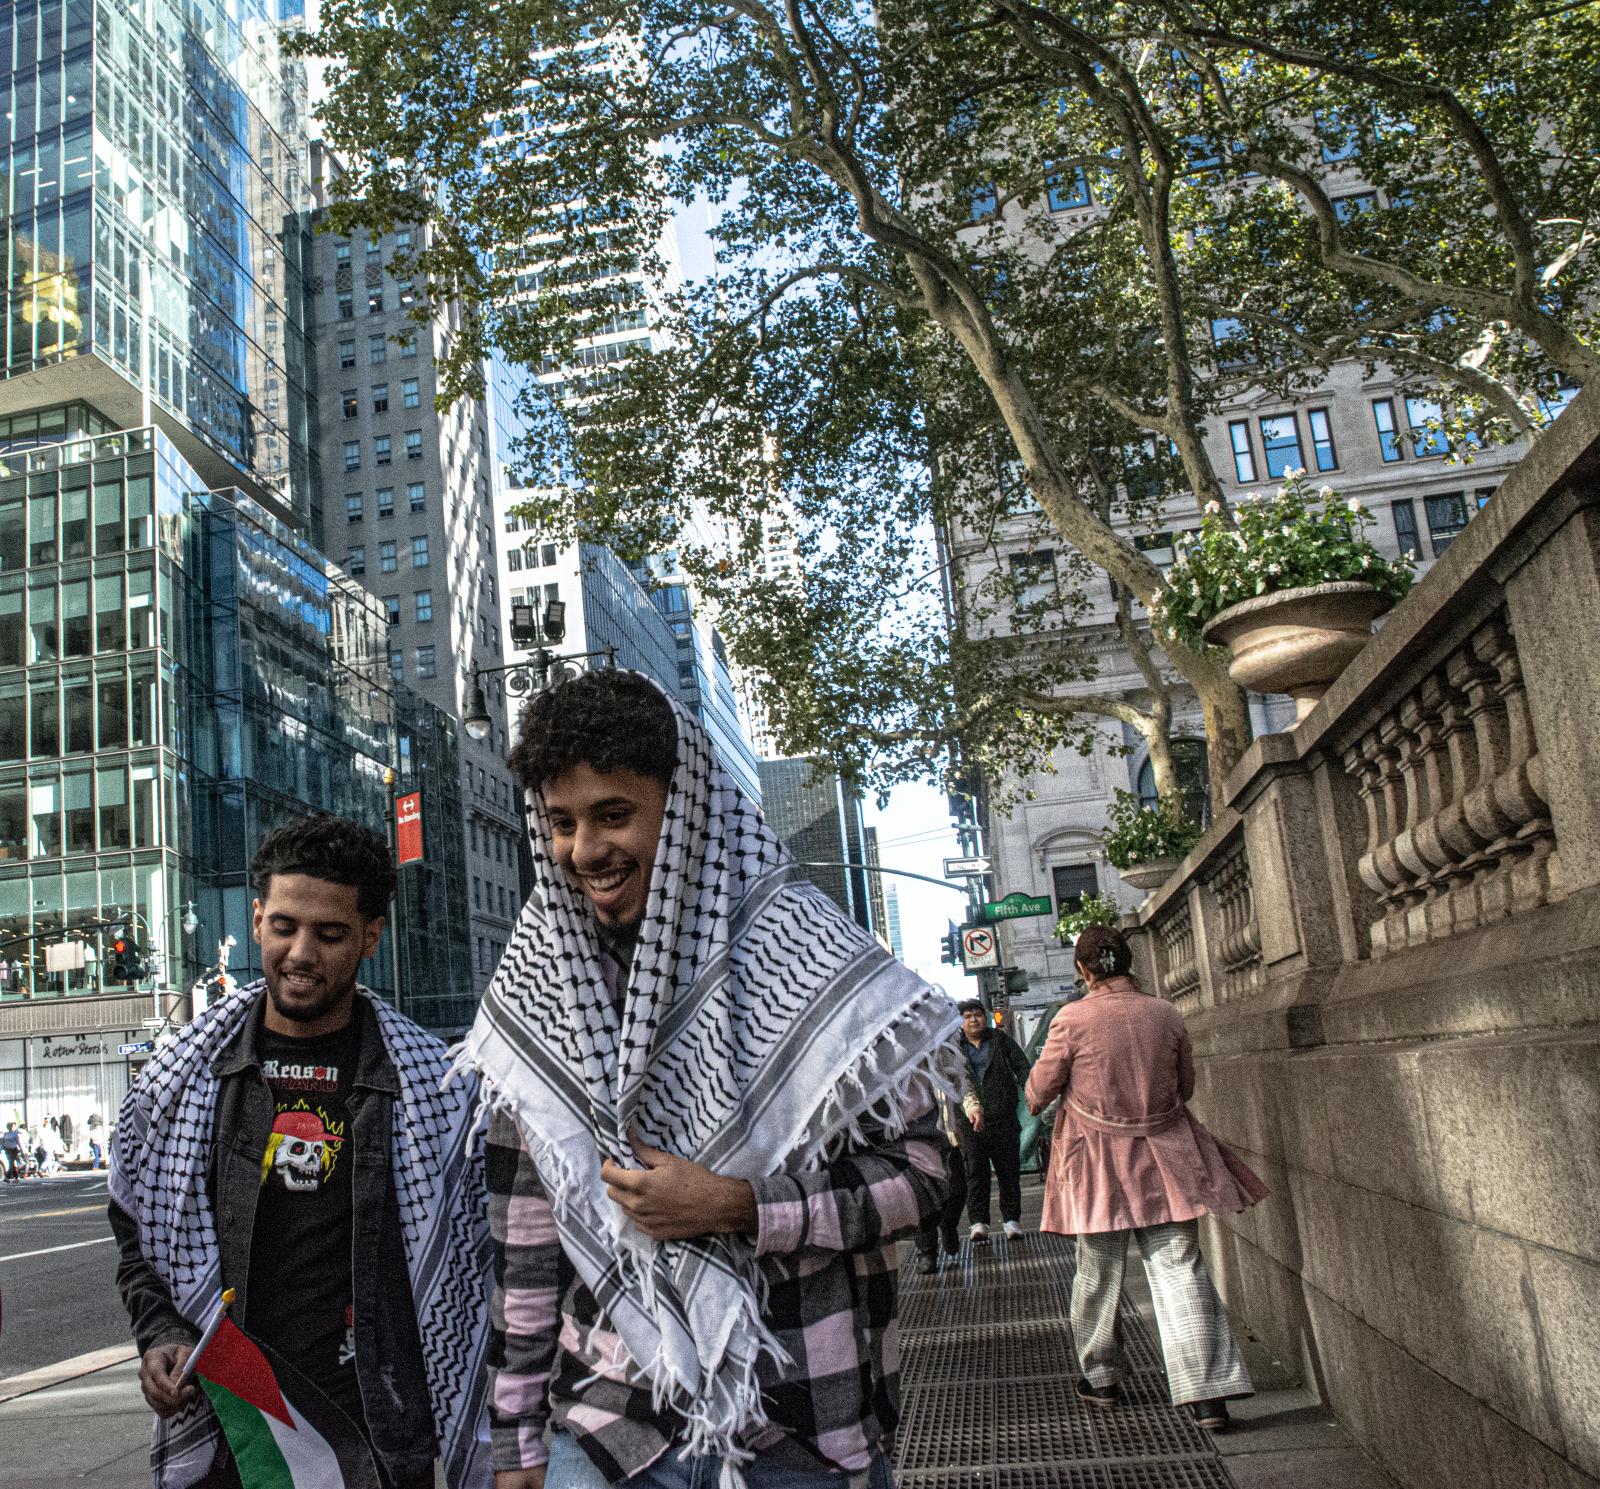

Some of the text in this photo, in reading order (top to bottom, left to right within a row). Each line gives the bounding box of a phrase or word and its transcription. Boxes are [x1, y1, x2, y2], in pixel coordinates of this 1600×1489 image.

[994, 903, 1041, 916] Fifth Ave
[262, 1060, 338, 1081] Reason
